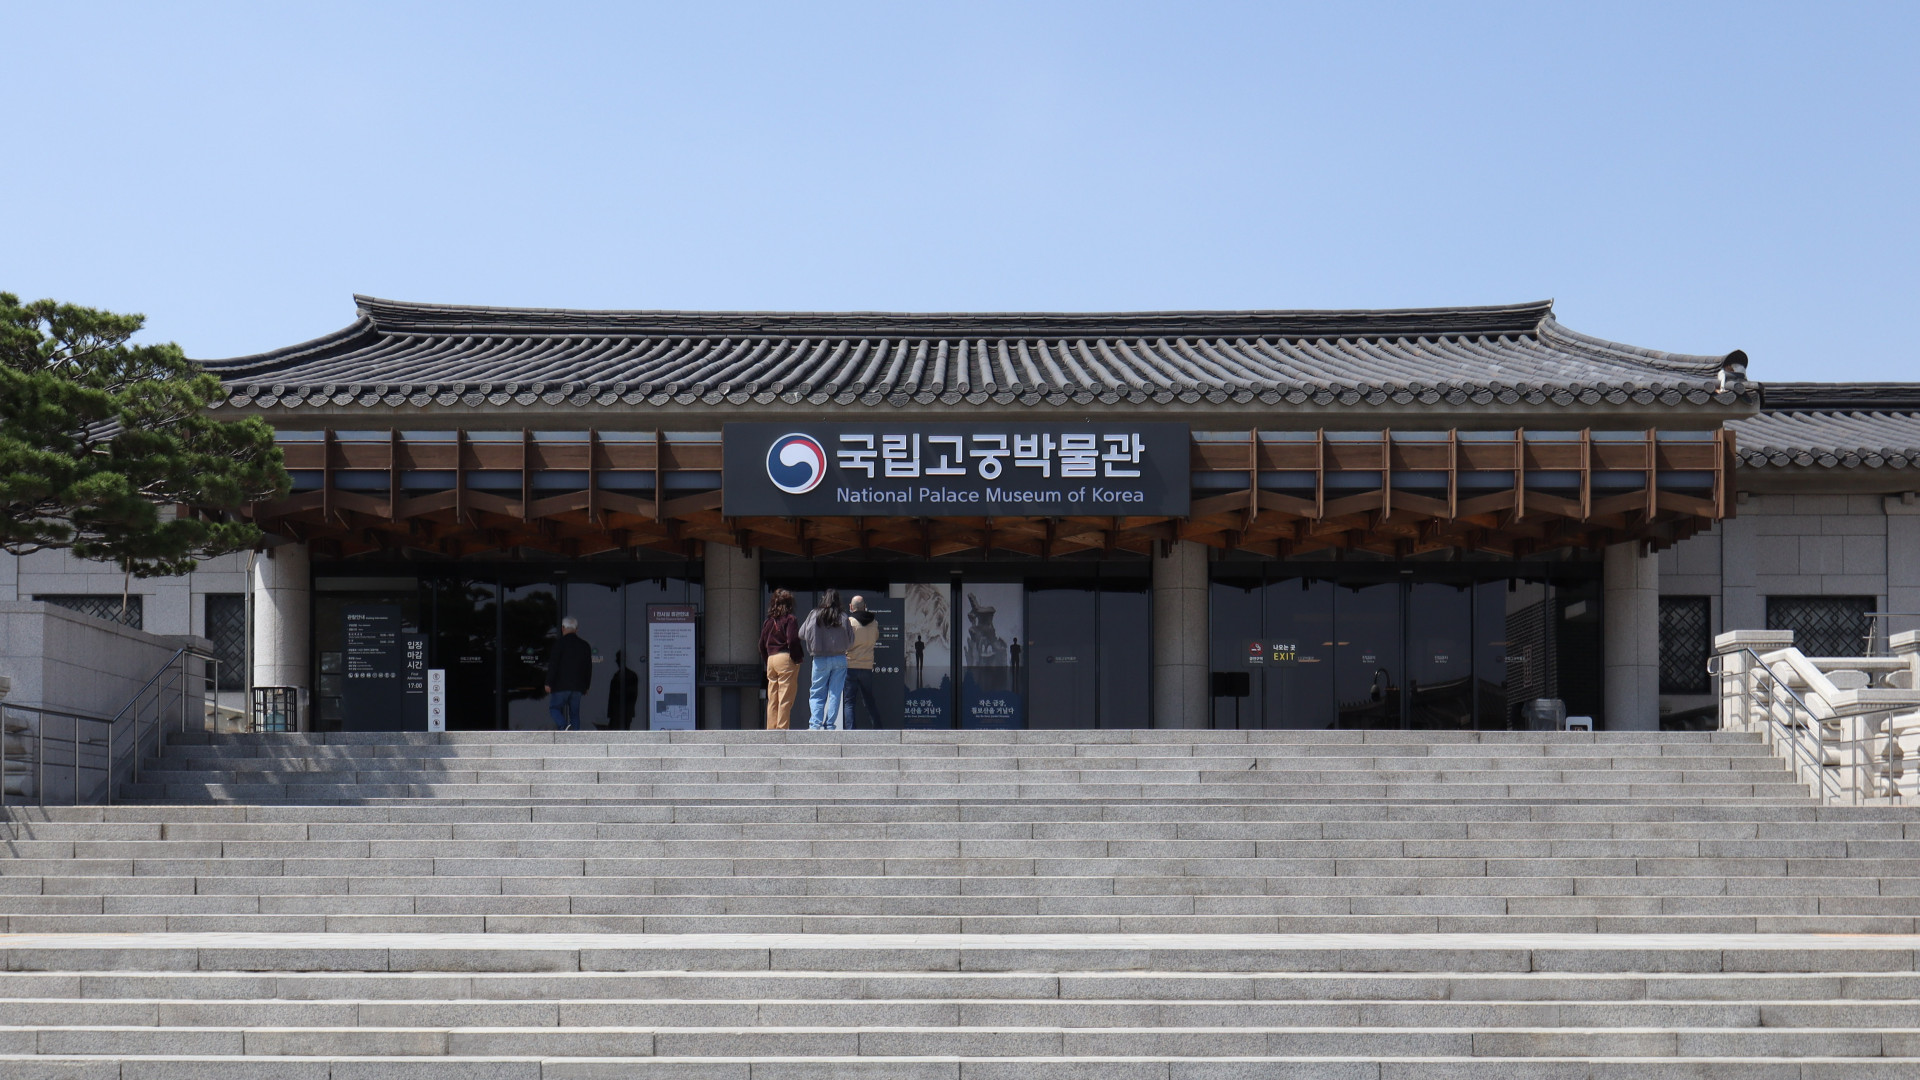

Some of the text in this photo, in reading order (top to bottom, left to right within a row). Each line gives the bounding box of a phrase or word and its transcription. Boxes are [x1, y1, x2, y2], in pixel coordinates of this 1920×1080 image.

[836, 433, 1146, 480] 국립고궁박물관
[836, 487, 1145, 503] National Palace Museum of Korea
[407, 641, 423, 650] 입장
[407, 651, 423, 660] 마감
[1273, 652, 1295, 661] EXIT
[407, 661, 423, 670] 시간
